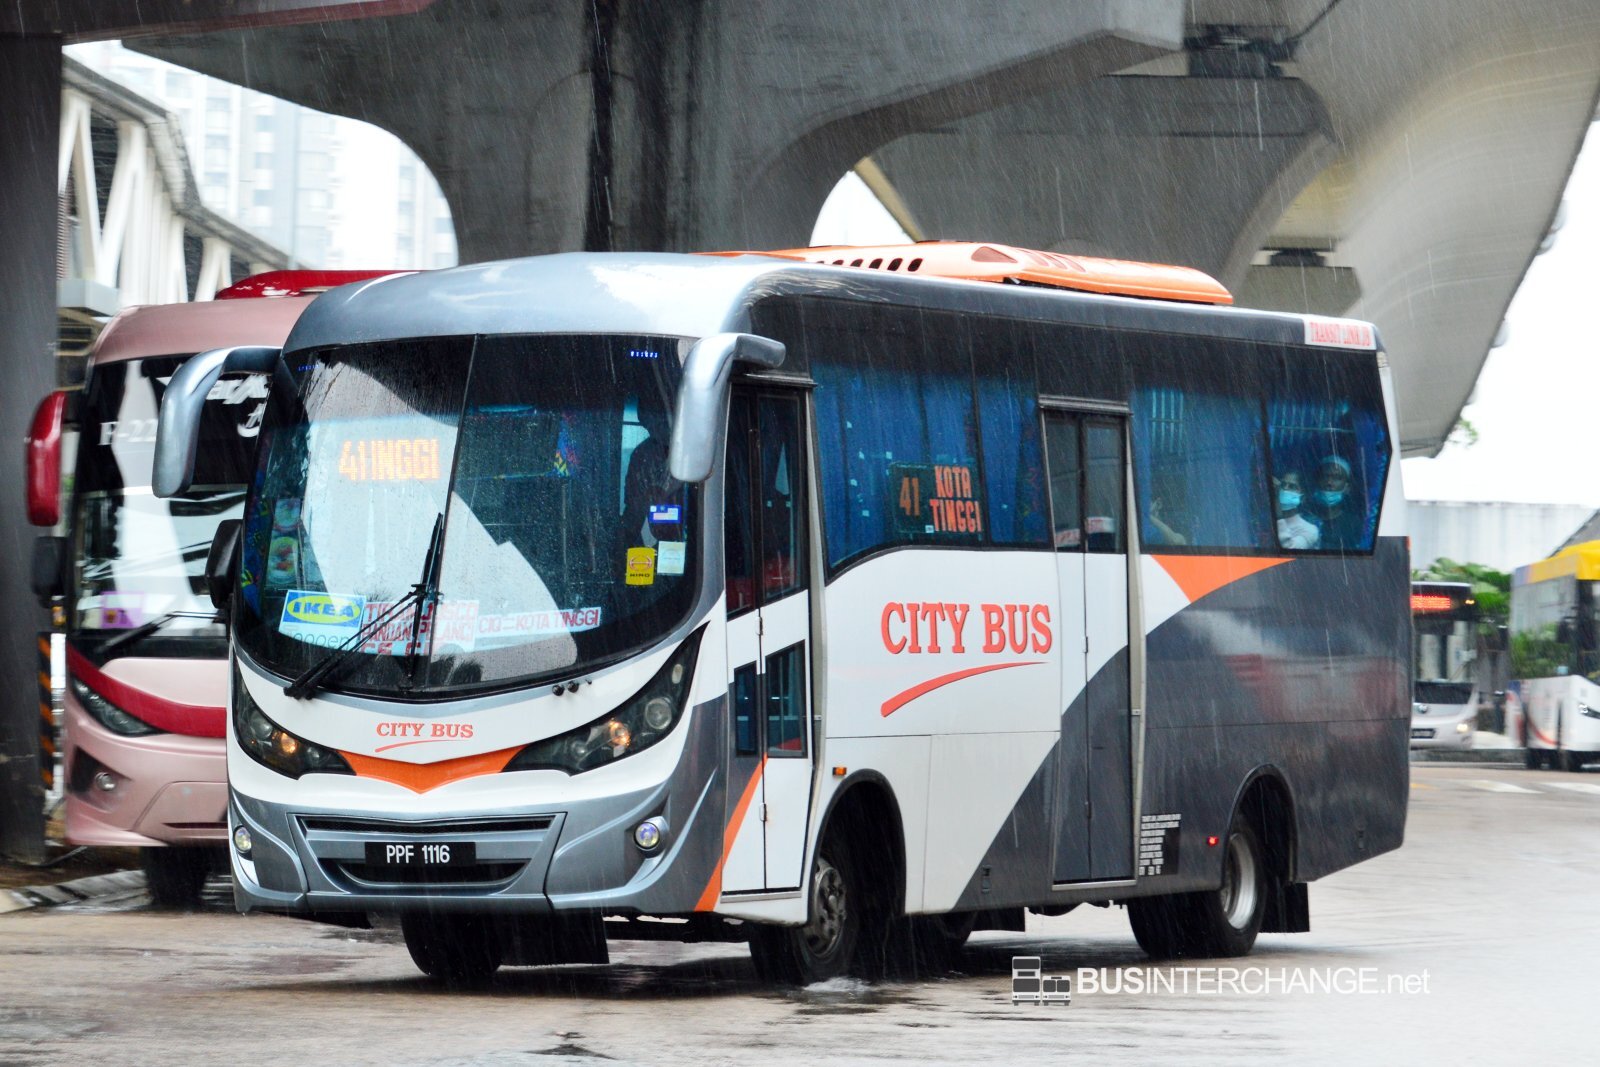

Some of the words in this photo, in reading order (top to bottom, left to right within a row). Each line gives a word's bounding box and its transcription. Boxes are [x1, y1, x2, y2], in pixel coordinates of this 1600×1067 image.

[934, 465, 972, 499] KOTA
[899, 476, 920, 516] 41
[929, 499, 982, 533] TINGGI
[292, 601, 354, 618] IKEA
[554, 609, 600, 629] TINGGI
[880, 601, 970, 655] CITY
[980, 603, 1053, 655] BUS
[376, 722, 425, 737] CITY
[430, 723, 474, 738] BUS
[386, 845, 414, 864] PPF
[421, 844, 450, 864] 1116
